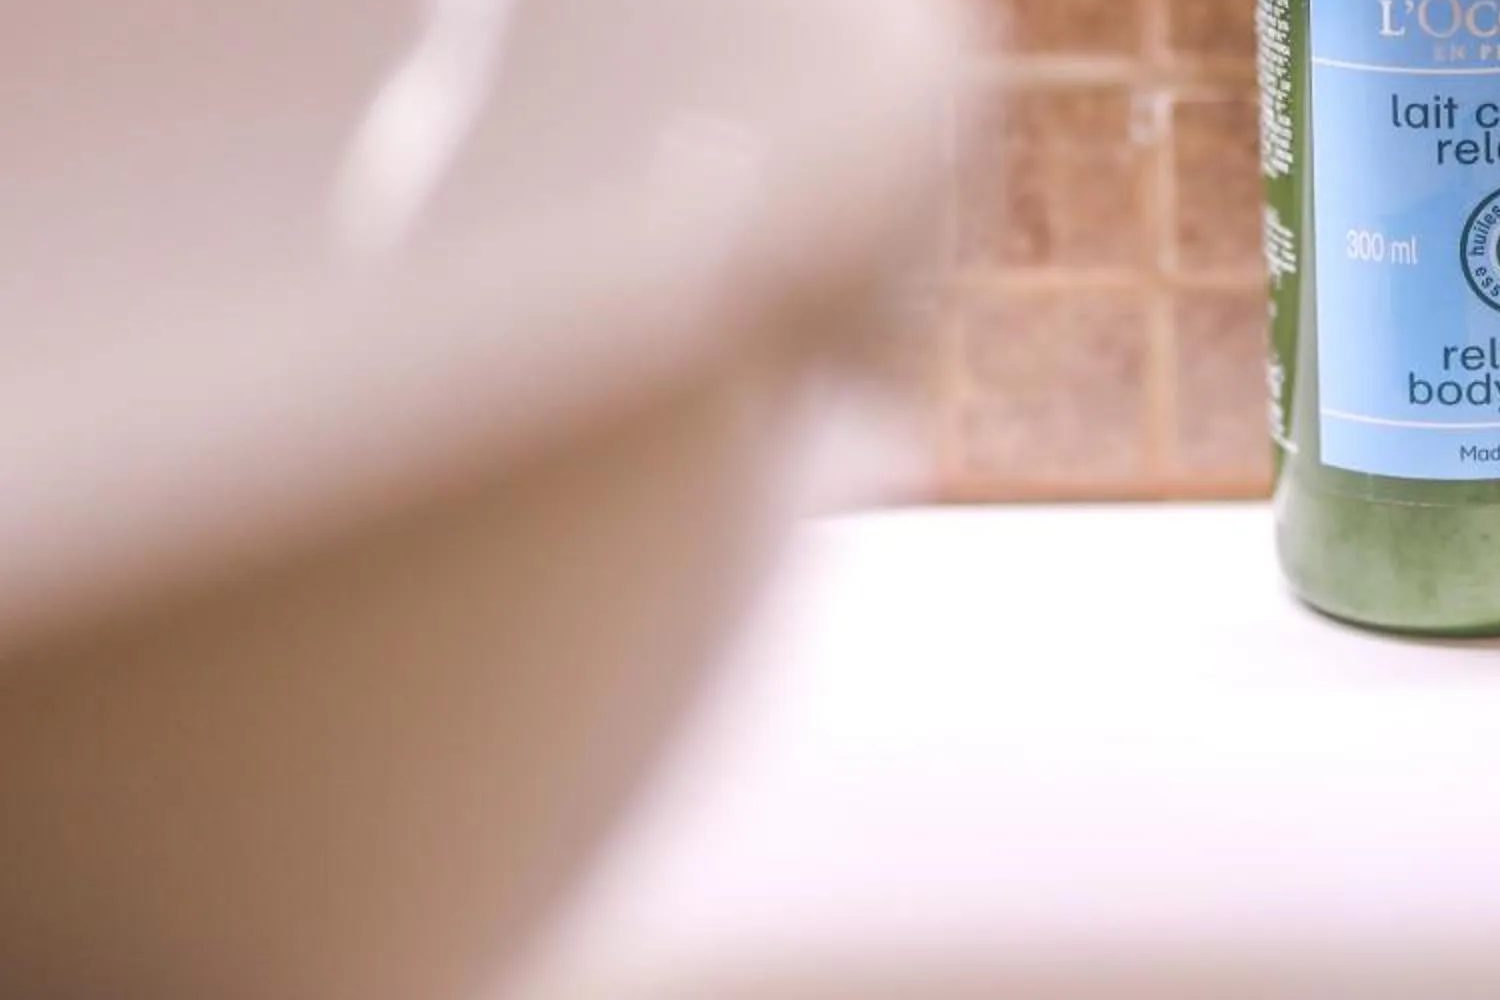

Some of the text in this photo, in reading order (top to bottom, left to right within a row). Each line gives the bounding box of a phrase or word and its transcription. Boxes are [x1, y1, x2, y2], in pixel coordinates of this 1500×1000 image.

[1392, 93, 1459, 129] lait
[1346, 228, 1419, 266] 300 ml
